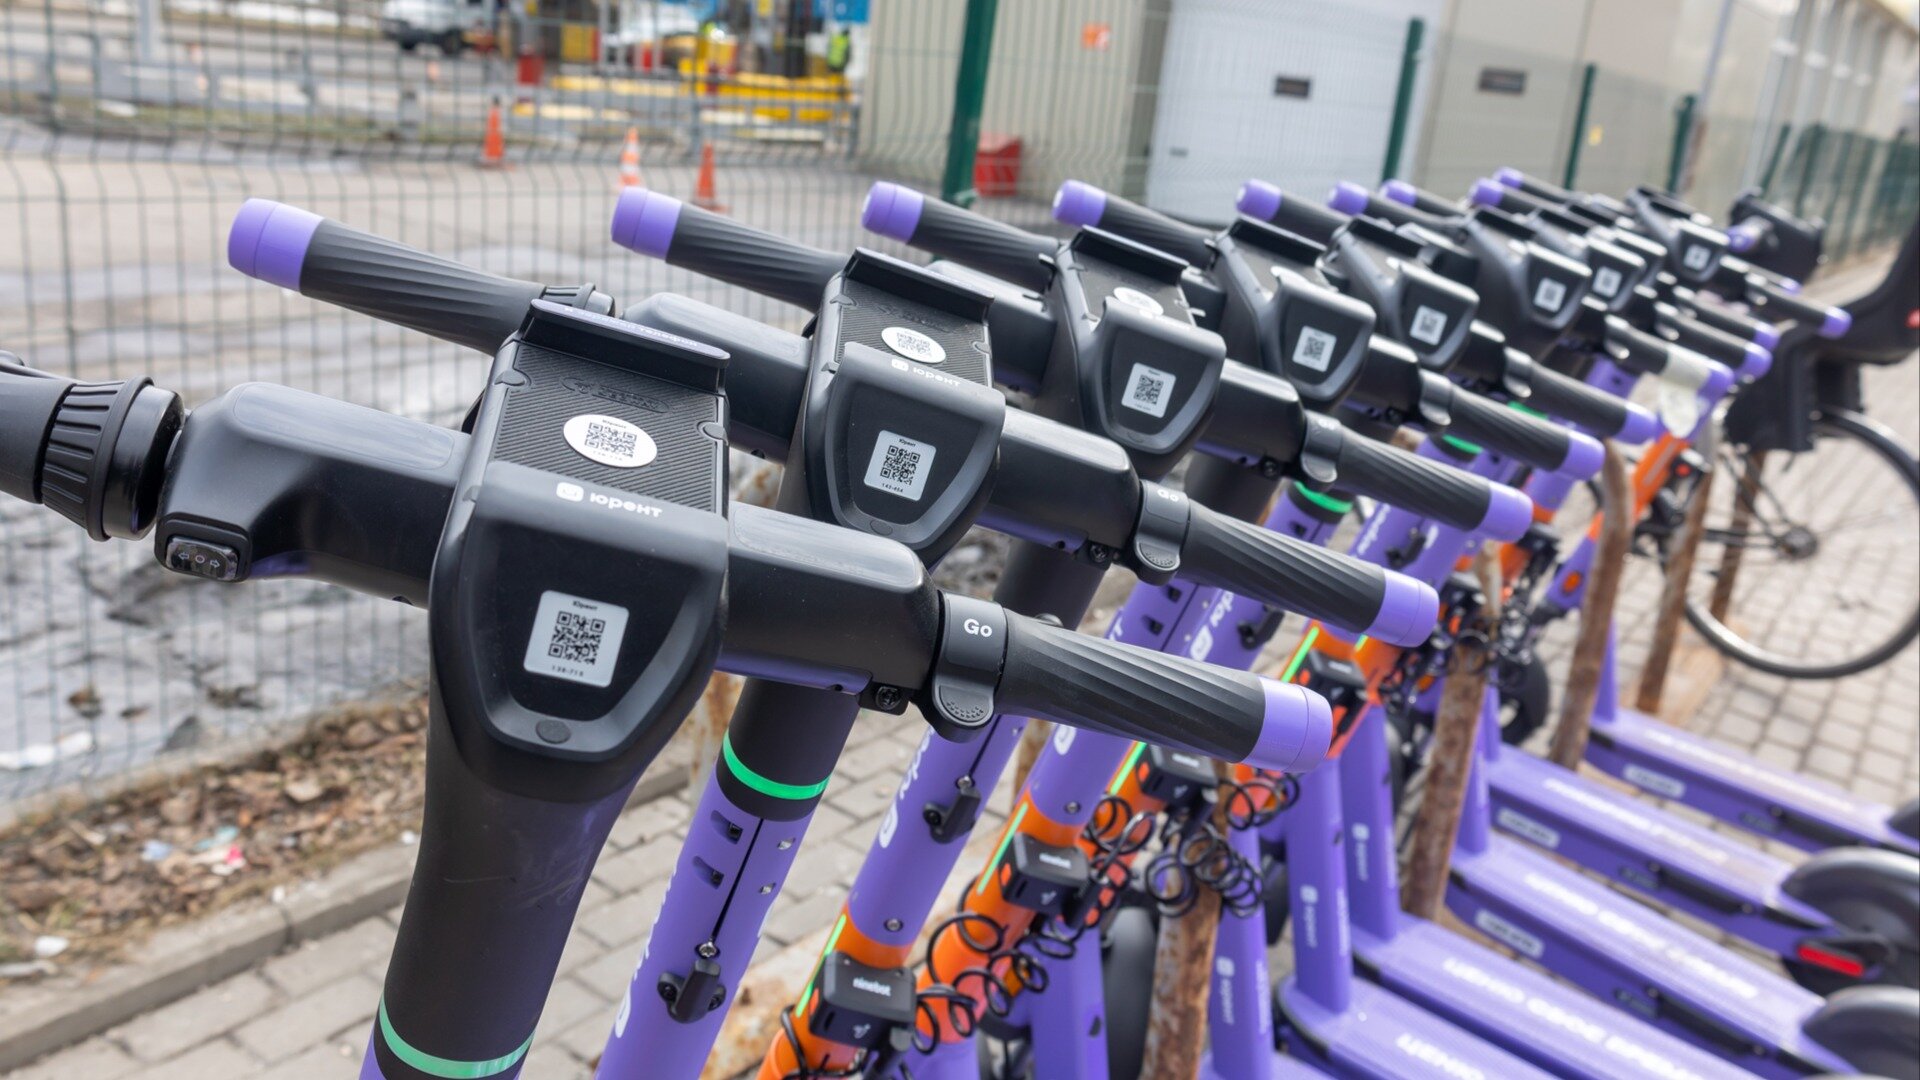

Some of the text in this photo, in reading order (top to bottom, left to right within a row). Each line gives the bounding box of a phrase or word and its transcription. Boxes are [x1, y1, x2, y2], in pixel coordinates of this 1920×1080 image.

[913, 367, 961, 387] юрент
[589, 492, 663, 518] юрент
[963, 618, 993, 638] Go
